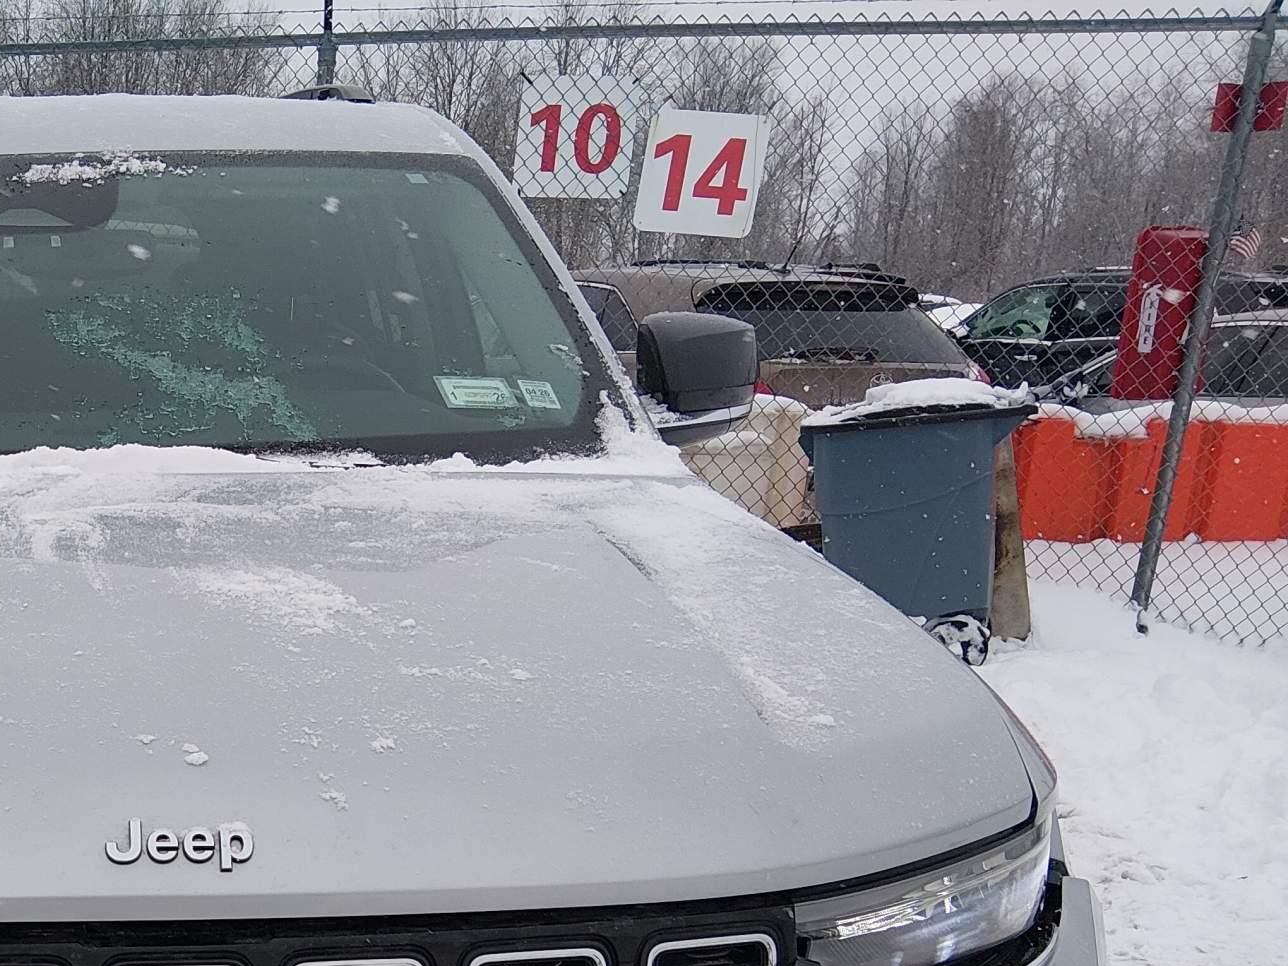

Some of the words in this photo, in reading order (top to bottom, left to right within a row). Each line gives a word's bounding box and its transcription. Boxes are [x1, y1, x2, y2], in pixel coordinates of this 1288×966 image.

[530, 103, 621, 174] 10
[654, 134, 748, 216] 14
[105, 817, 255, 872] Jeep
